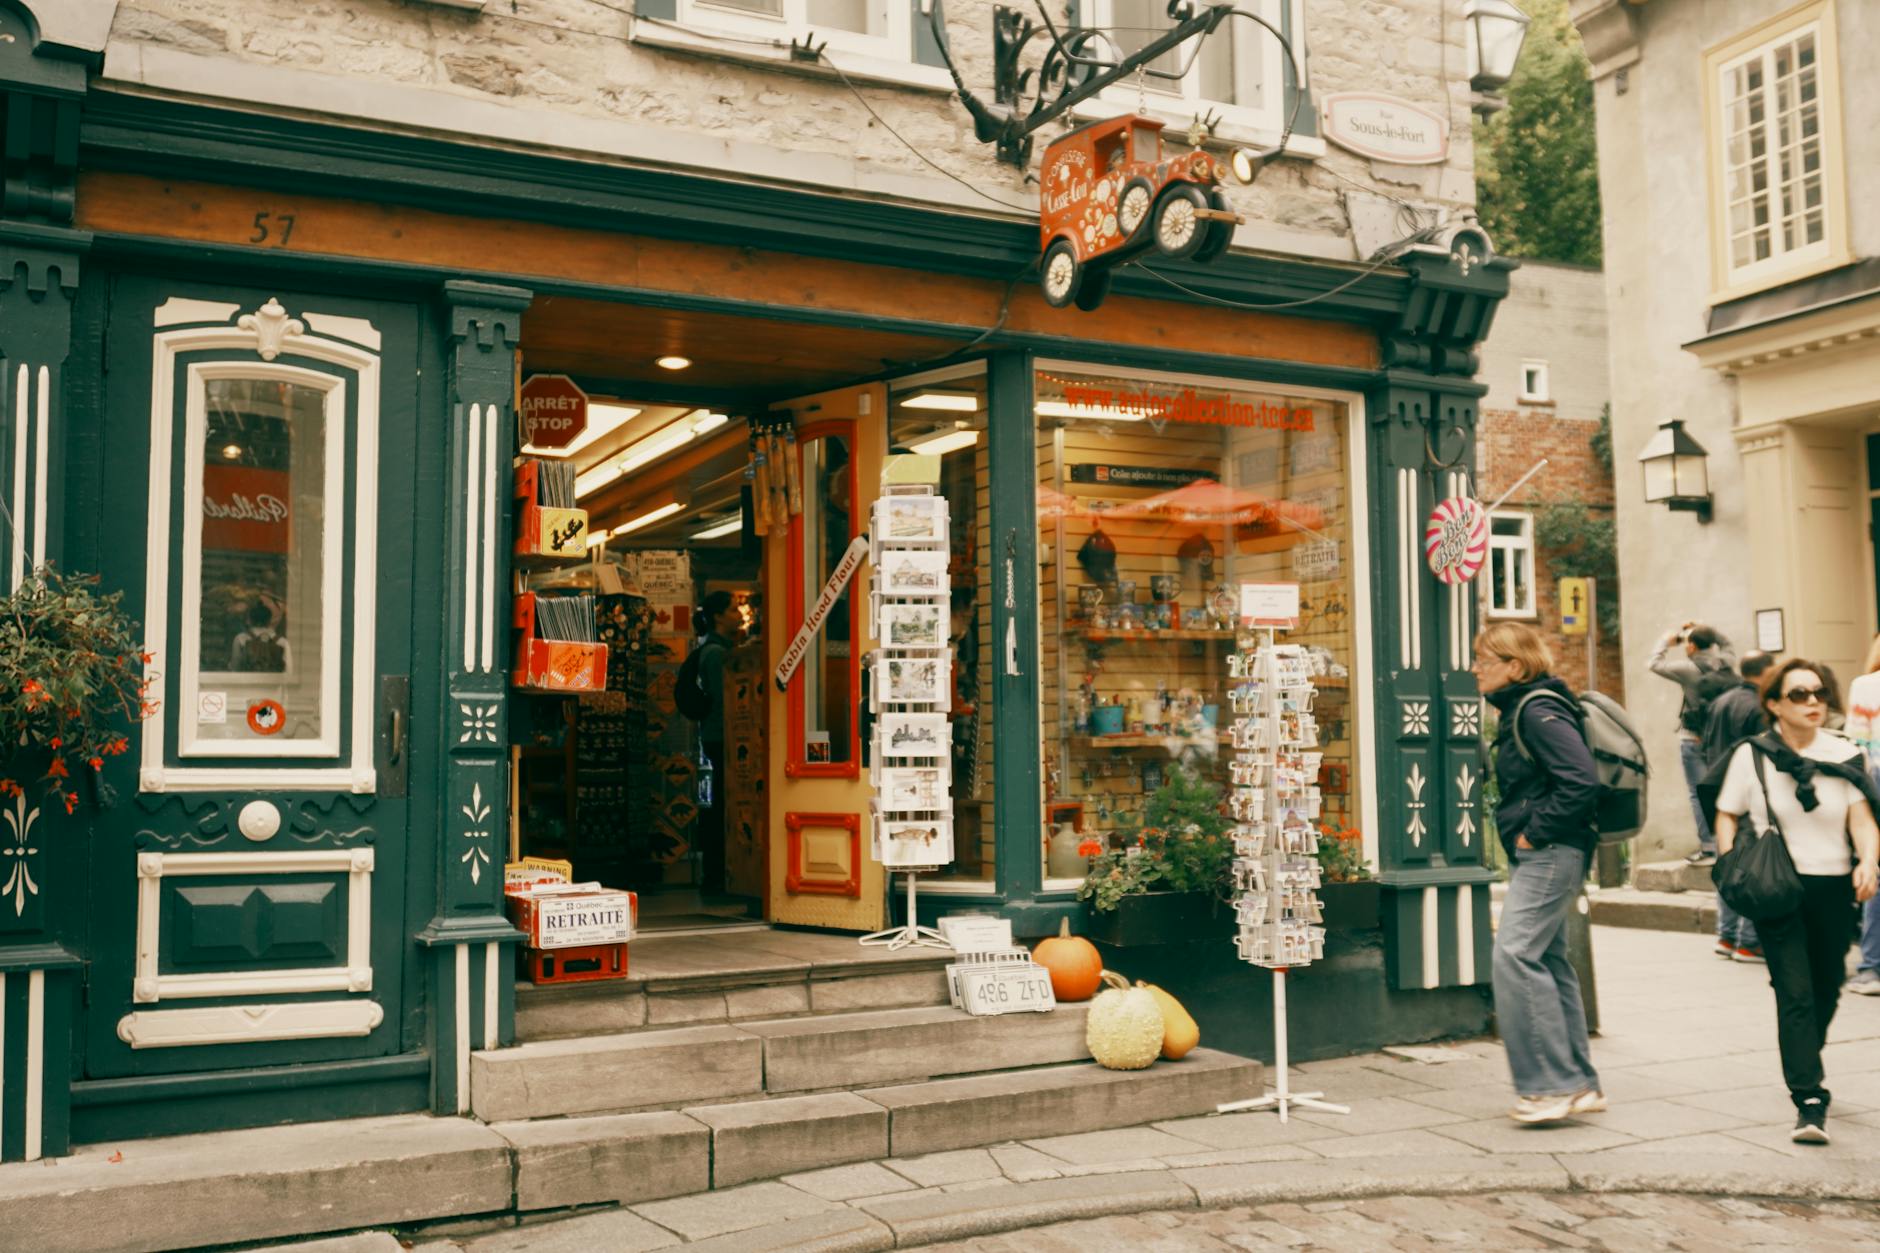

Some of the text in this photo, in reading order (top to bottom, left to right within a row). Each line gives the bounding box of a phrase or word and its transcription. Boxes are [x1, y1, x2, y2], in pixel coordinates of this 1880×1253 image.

[1350, 117, 1425, 142] Sous-le-Fort
[250, 212, 295, 245] 57
[522, 394, 580, 411] ARRÊT
[527, 417, 573, 431] STOP
[779, 552, 857, 677] Robin Hood Flour
[527, 863, 568, 877] WARNING
[1017, 979, 1050, 1001] ZFD
